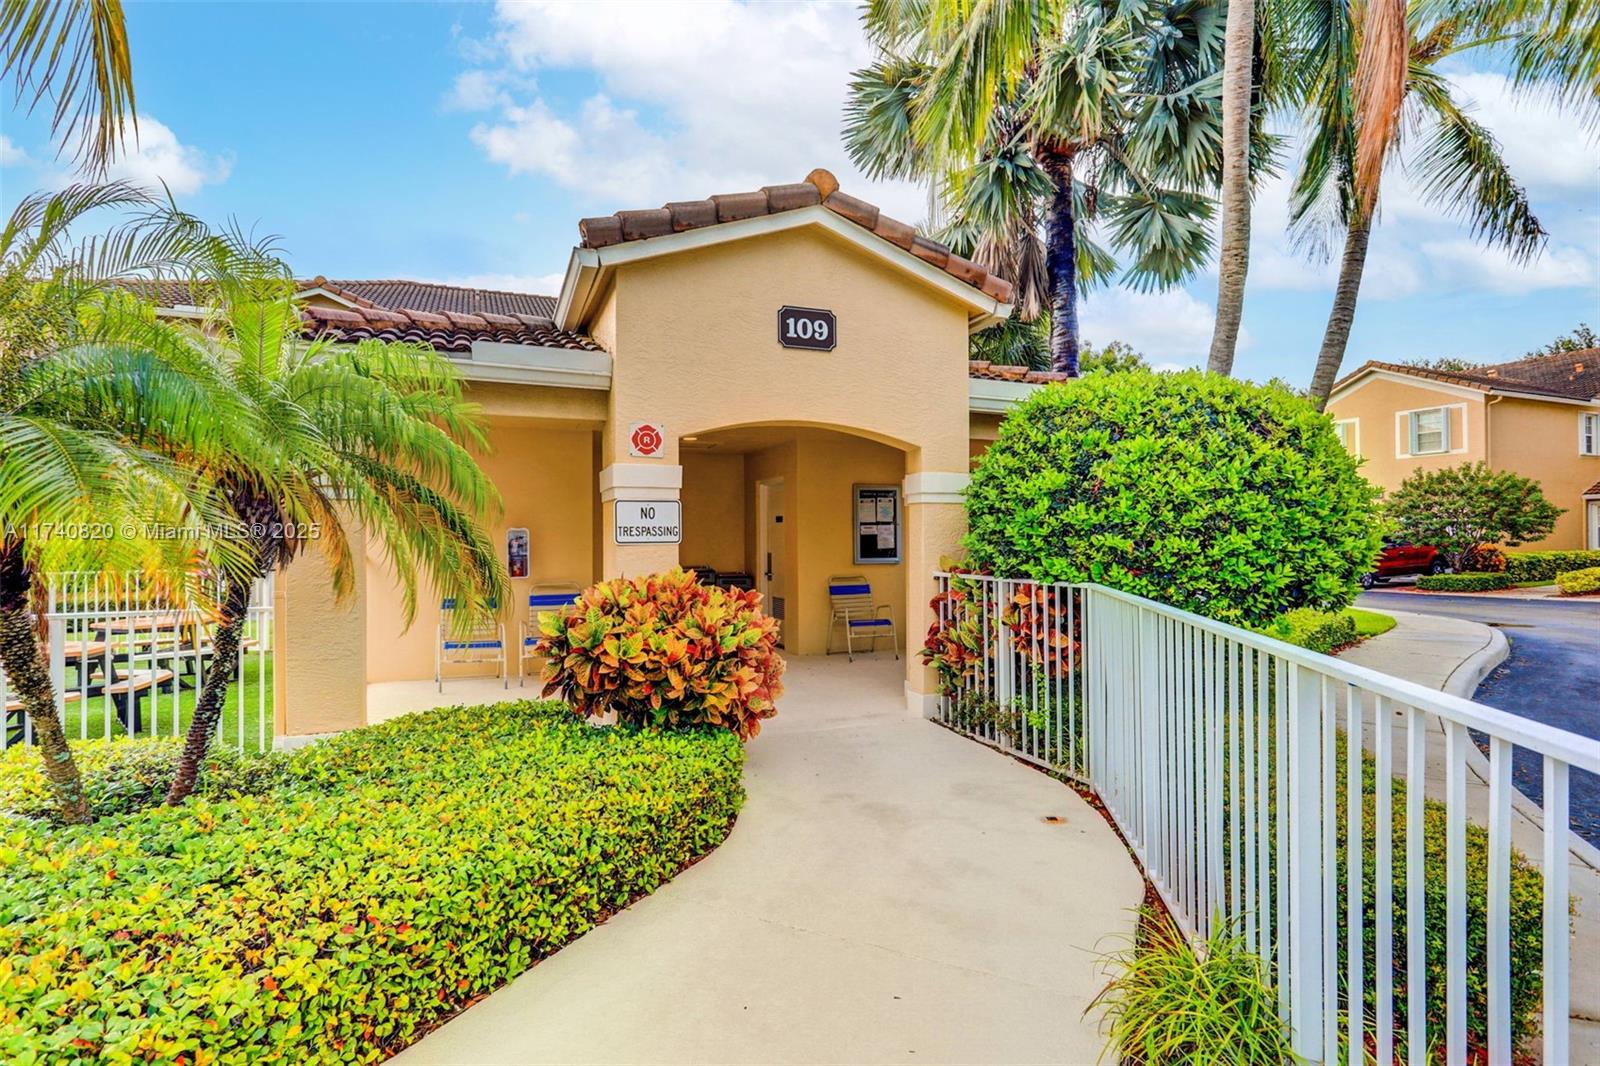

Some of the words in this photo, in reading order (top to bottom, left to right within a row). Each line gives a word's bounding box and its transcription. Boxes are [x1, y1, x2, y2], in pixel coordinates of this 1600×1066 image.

[785, 317, 829, 341] 109
[643, 436, 651, 444] R
[640, 507, 656, 520] NO
[618, 525, 679, 537] TRESPASSING
